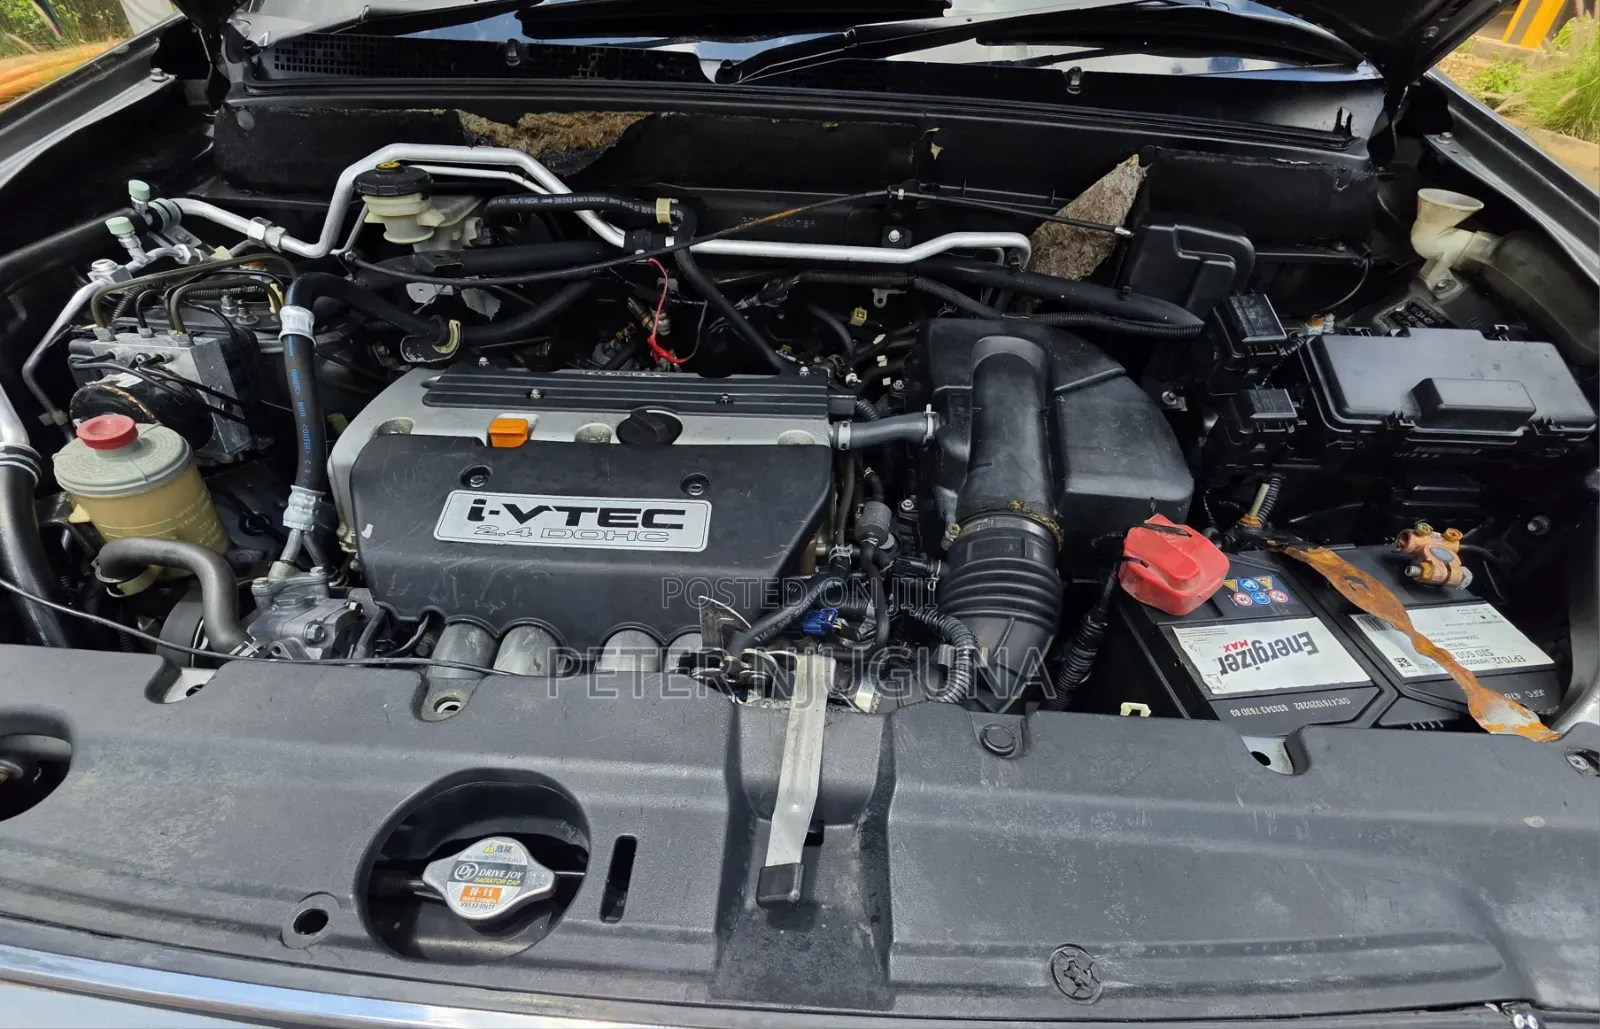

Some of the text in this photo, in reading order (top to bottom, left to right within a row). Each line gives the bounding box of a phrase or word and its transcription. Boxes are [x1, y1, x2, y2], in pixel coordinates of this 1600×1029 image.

[467, 498, 686, 530] i-VTEC
[474, 525, 670, 542] 2.4 DOHC
[1223, 639, 1249, 653] MAX
[1218, 631, 1320, 676] Energizer
[1456, 649, 1494, 659] 570 600
[478, 868, 506, 878] DRIVE
[505, 871, 524, 880] JOY
[474, 877, 506, 885] RADIATOR
[469, 887, 494, 897] N-11
